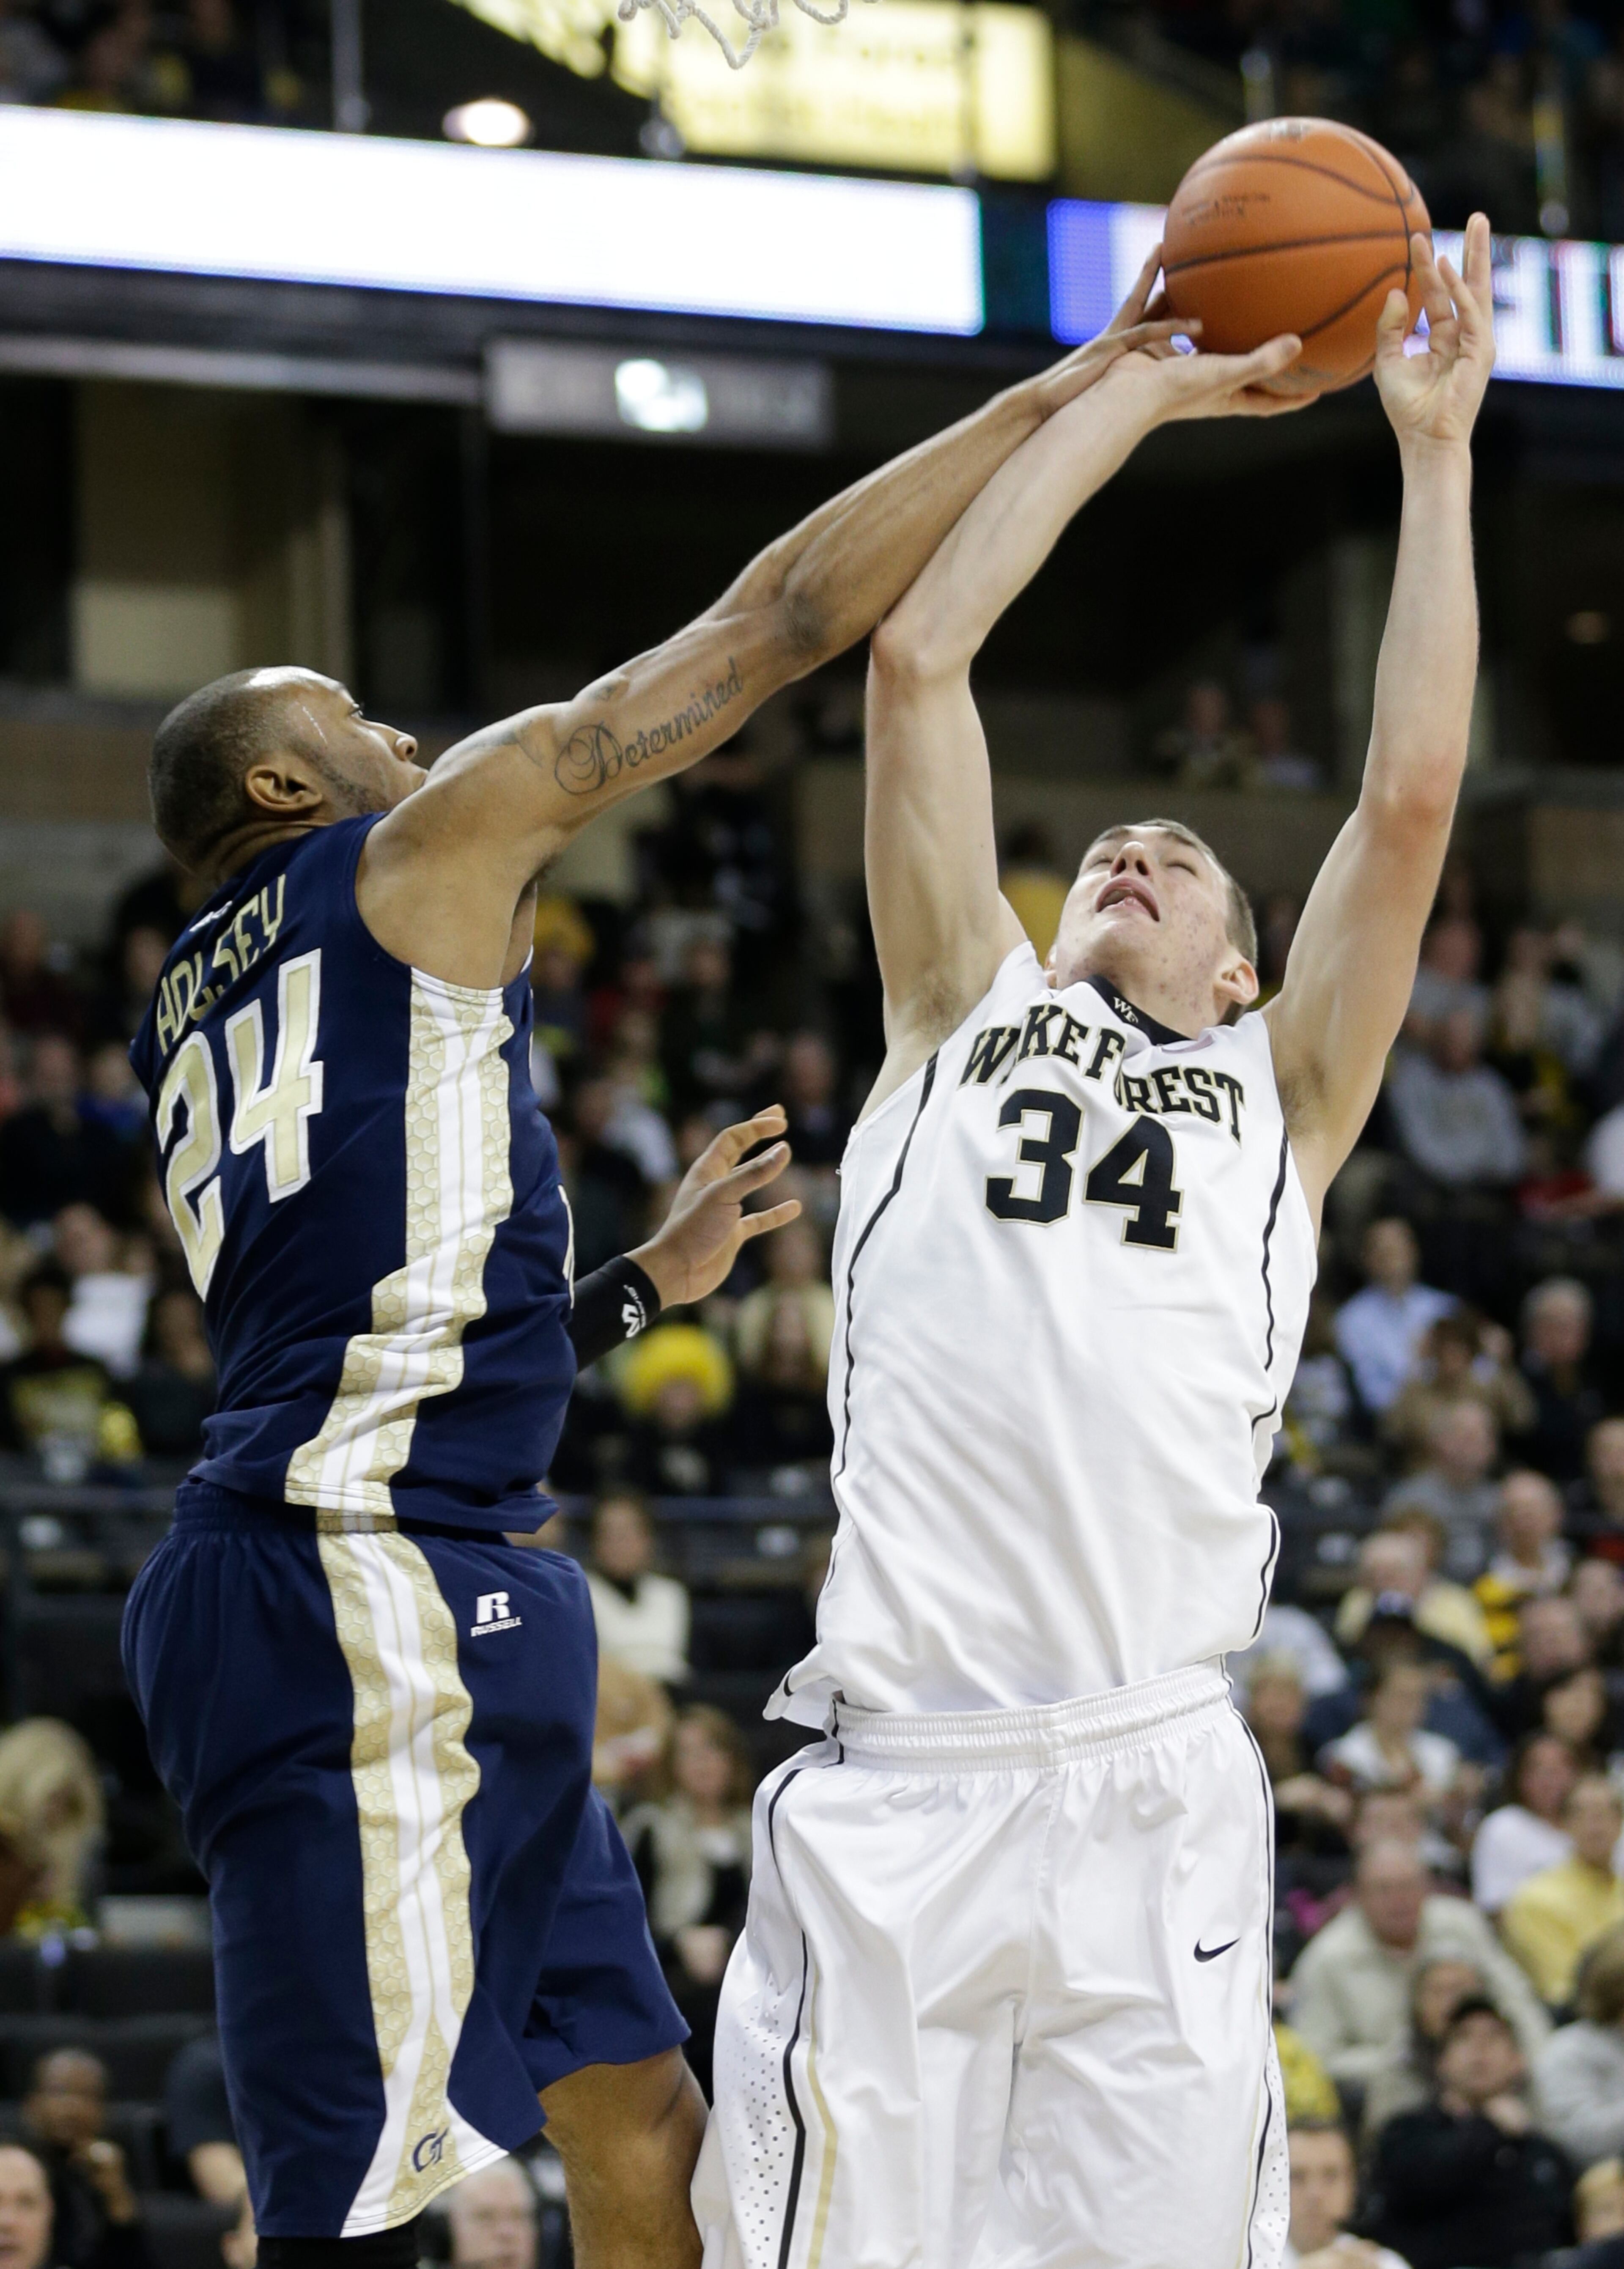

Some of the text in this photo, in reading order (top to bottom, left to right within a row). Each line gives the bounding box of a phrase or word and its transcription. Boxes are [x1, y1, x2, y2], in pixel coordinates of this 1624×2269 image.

[555, 656, 743, 795] Determined
[957, 1004, 1092, 1090] WKE
[1113, 996, 1138, 1024] WF
[156, 948, 324, 1302] 24
[985, 1088, 1185, 1253] 34
[470, 1616, 523, 1637] RUSSELL
[476, 1591, 510, 1624] R
